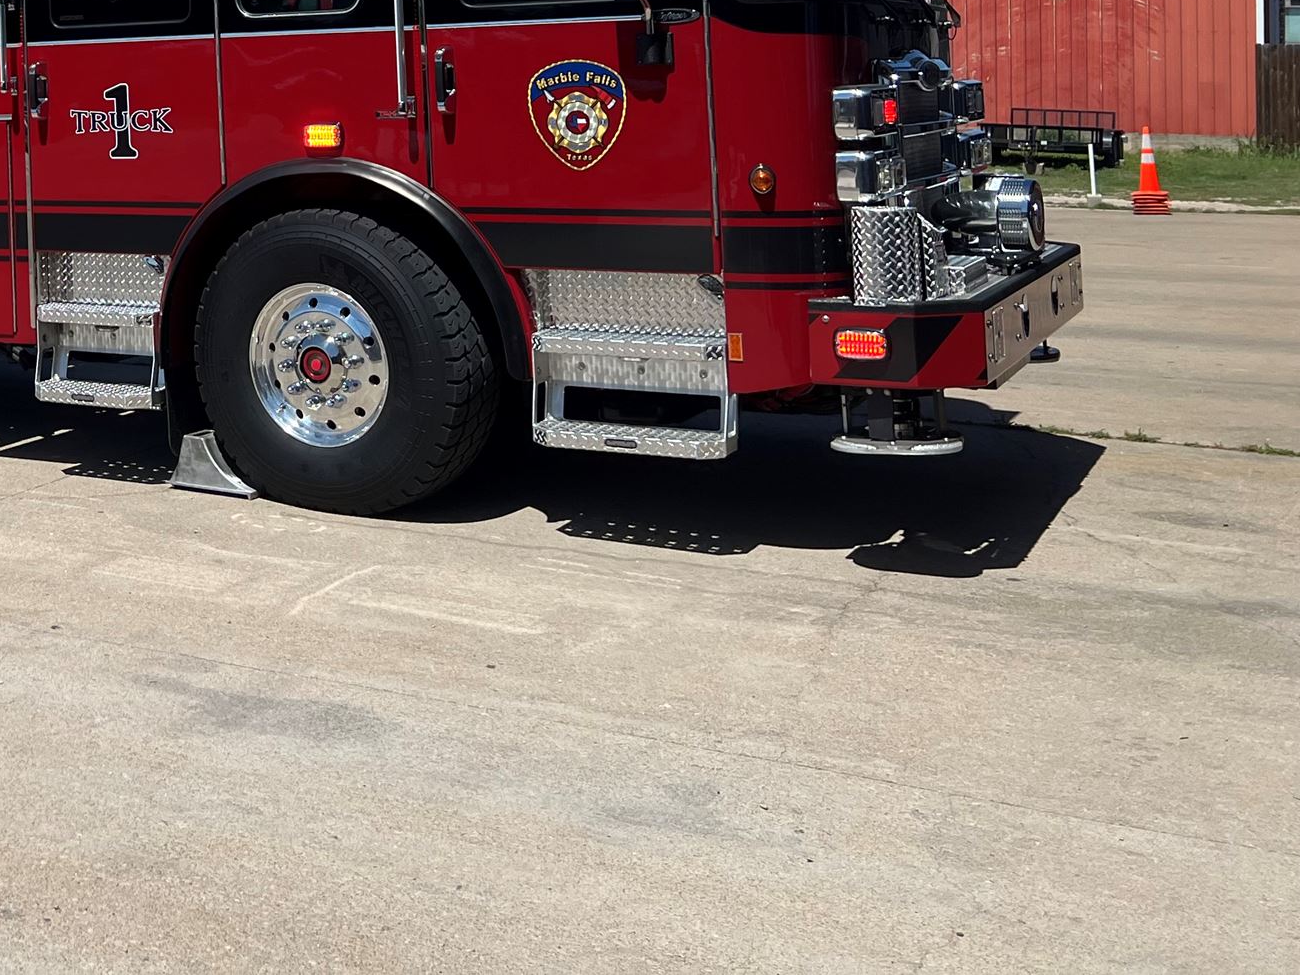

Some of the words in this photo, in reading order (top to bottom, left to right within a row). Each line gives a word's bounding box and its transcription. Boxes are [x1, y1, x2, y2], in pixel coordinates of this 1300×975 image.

[536, 71, 580, 90] Marble
[585, 71, 617, 88] Falls
[69, 107, 173, 134] TRUCK
[103, 82, 138, 159] 1
[566, 153, 593, 161] Texas
